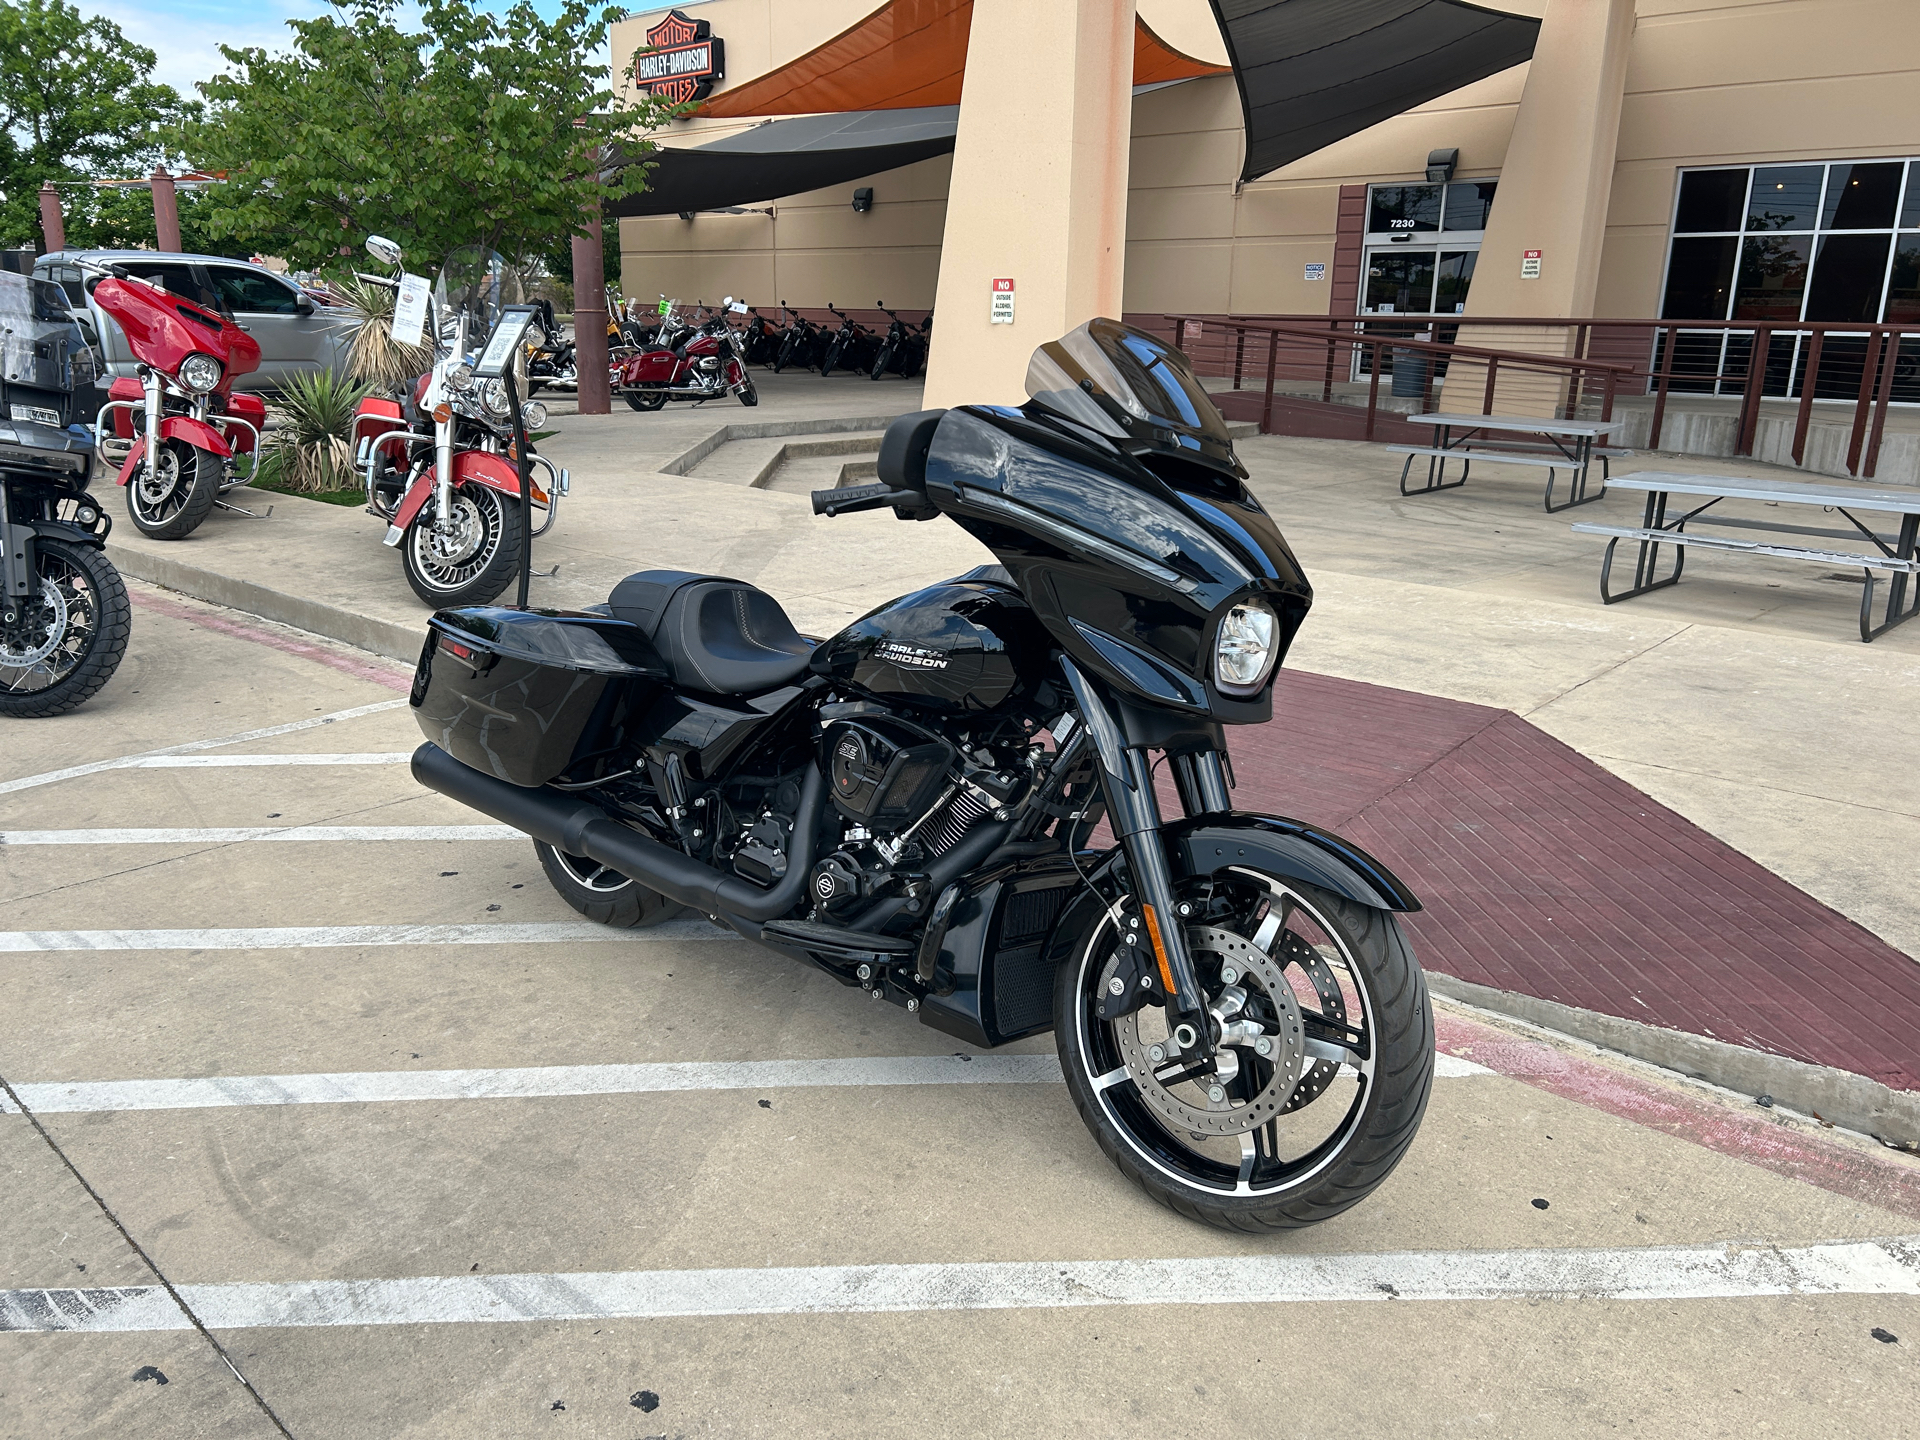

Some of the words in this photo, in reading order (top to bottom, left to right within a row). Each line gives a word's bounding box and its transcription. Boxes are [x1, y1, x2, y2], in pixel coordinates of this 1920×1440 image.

[654, 22, 691, 47] MOTOR
[640, 47, 708, 79] HARLEY-DAVIDSON
[1390, 219, 1415, 228] 7230
[998, 281, 1010, 290] NO
[873, 649, 948, 669] DAVIDSON
